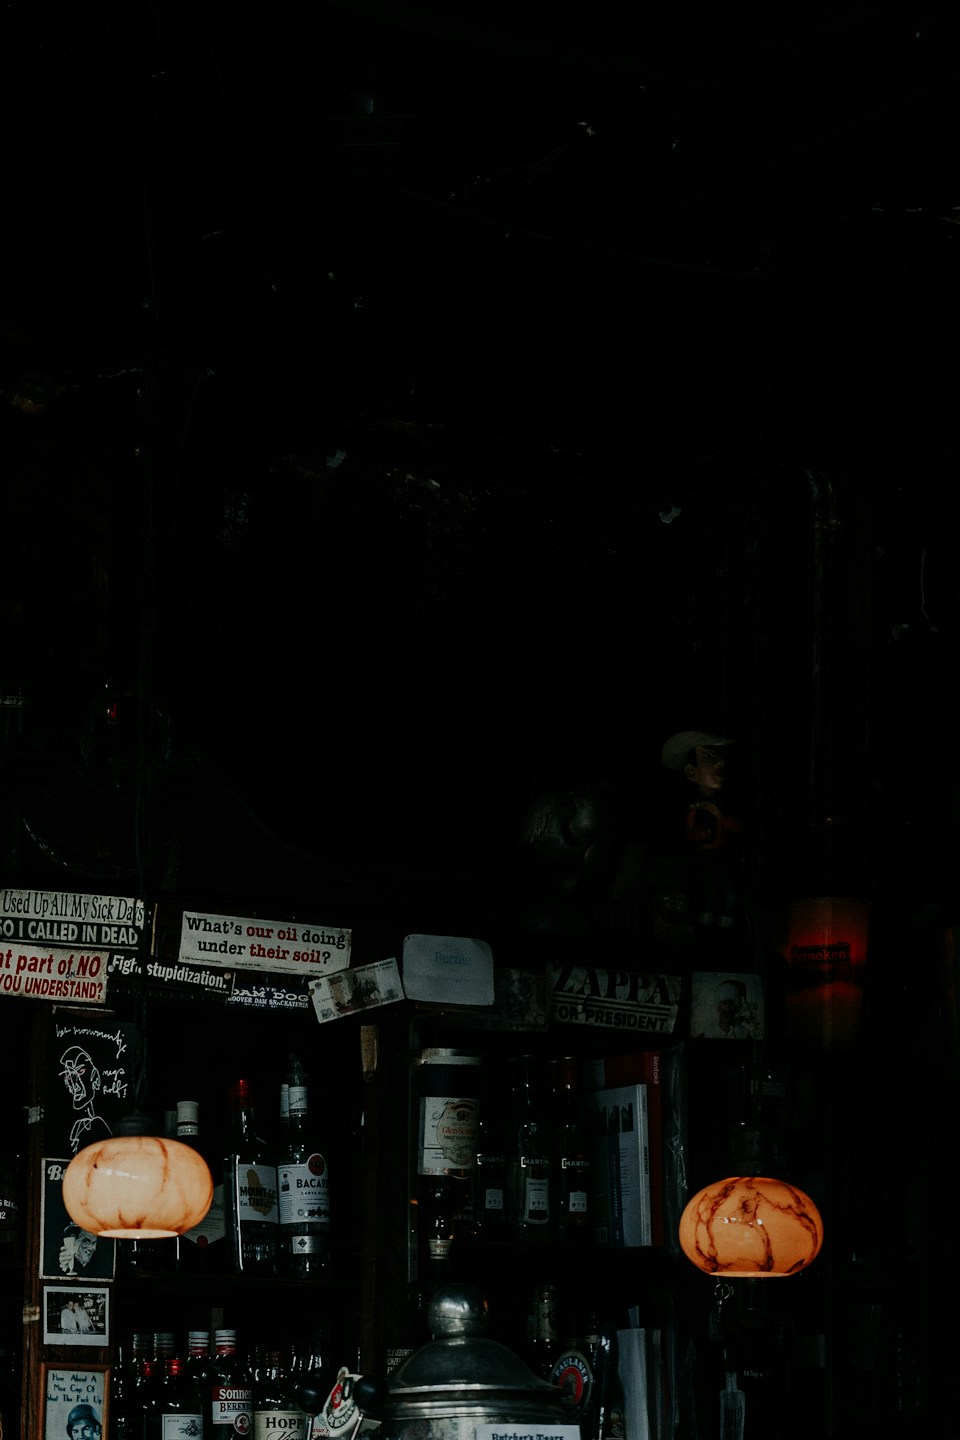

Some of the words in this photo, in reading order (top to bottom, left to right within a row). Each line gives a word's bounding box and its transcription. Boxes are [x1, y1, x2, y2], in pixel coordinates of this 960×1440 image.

[3, 891, 30, 915] Used
[33, 891, 49, 920] Up
[51, 893, 69, 916] All
[72, 895, 88, 922] My
[90, 897, 113, 921] Sick
[19, 920, 24, 938] I
[27, 920, 78, 942] CALLED
[81, 923, 99, 943] IN
[100, 925, 139, 946] DEAD
[187, 917, 243, 936] What's
[246, 926, 274, 939] our
[277, 927, 297, 942] oil
[301, 929, 346, 949] doing
[198, 940, 246, 956] under
[249, 944, 290, 960] their
[292, 947, 331, 964] soil?
[16, 952, 52, 976] part
[57, 954, 73, 977] of
[76, 955, 101, 977] NO
[146, 962, 227, 989] stupidization.
[24, 976, 103, 999] UNDERSTAND?
[552, 964, 670, 1005] ZAPPA
[552, 1003, 579, 1021] FOR
[585, 1007, 669, 1032] PRESIDENT
[240, 1186, 267, 1197] MOUNT
[0, 1211, 6, 1220] 12
[52, 1373, 64, 1381] How
[71, 1374, 87, 1382] About
[70, 1384, 82, 1393] Cup
[62, 1394, 72, 1402] The
[93, 1395, 102, 1404] Up
[266, 1417, 303, 1430] HOPP
